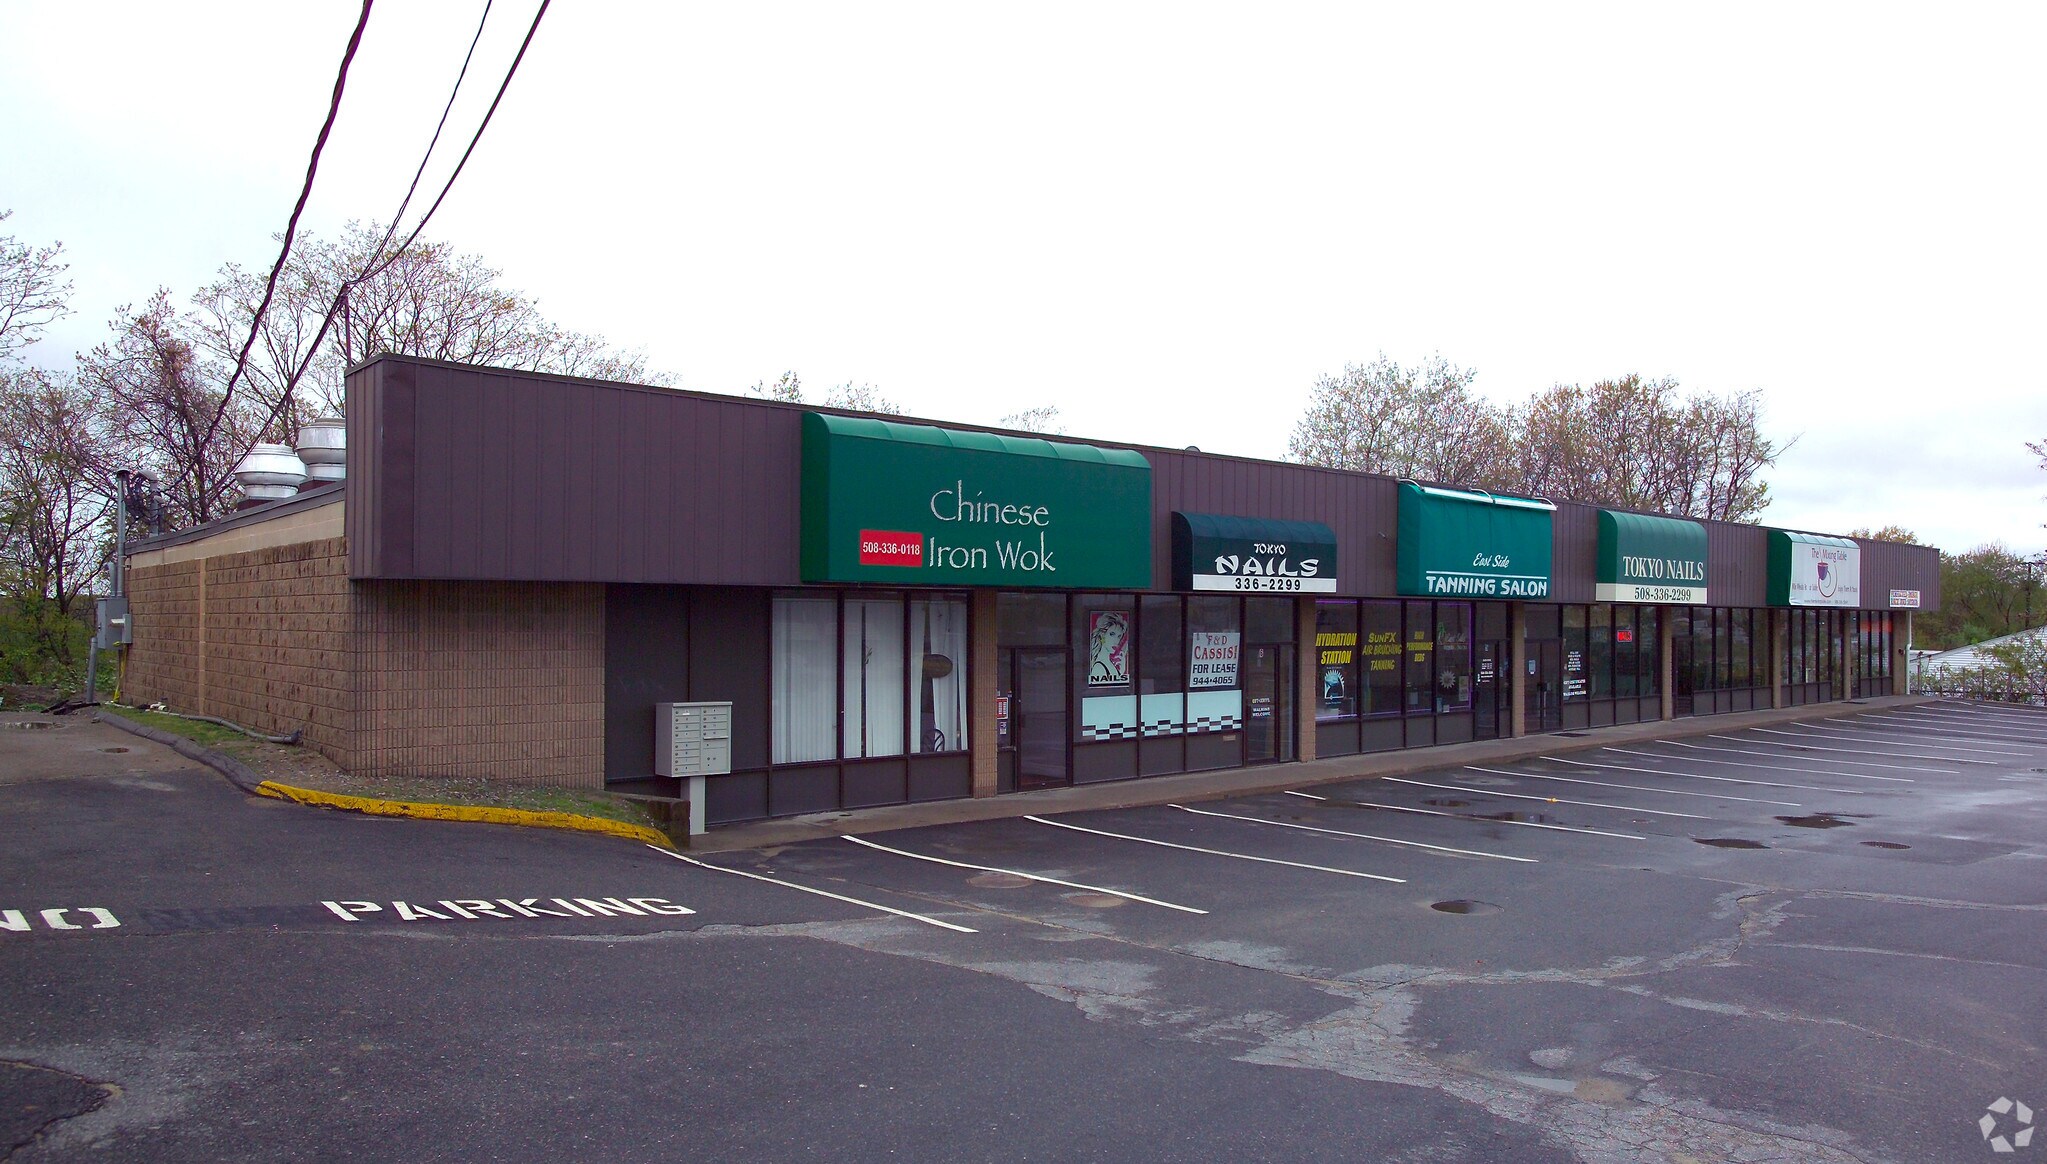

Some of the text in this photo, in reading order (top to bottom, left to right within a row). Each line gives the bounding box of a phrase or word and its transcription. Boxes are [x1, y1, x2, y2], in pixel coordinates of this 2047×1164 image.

[930, 479, 1050, 527] Chinese
[862, 541, 921, 556] 508-336-0118
[929, 530, 1056, 571] Iron Wok
[1253, 543, 1286, 556] TOKYO
[1214, 554, 1320, 577] NAILS
[1472, 552, 1510, 569] East Side
[1622, 556, 1704, 581] TOKYO NAILS
[1235, 577, 1301, 591] 336-2299
[1425, 575, 1548, 597] TANNING SALON
[1634, 587, 1691, 602] 508-336-2299
[1315, 632, 1358, 647] HYDRATION
[1320, 650, 1352, 665] STATION
[1192, 663, 1237, 674] FOR LEASE
[1090, 674, 1129, 682] NAILS
[320, 897, 697, 921] PARKING
